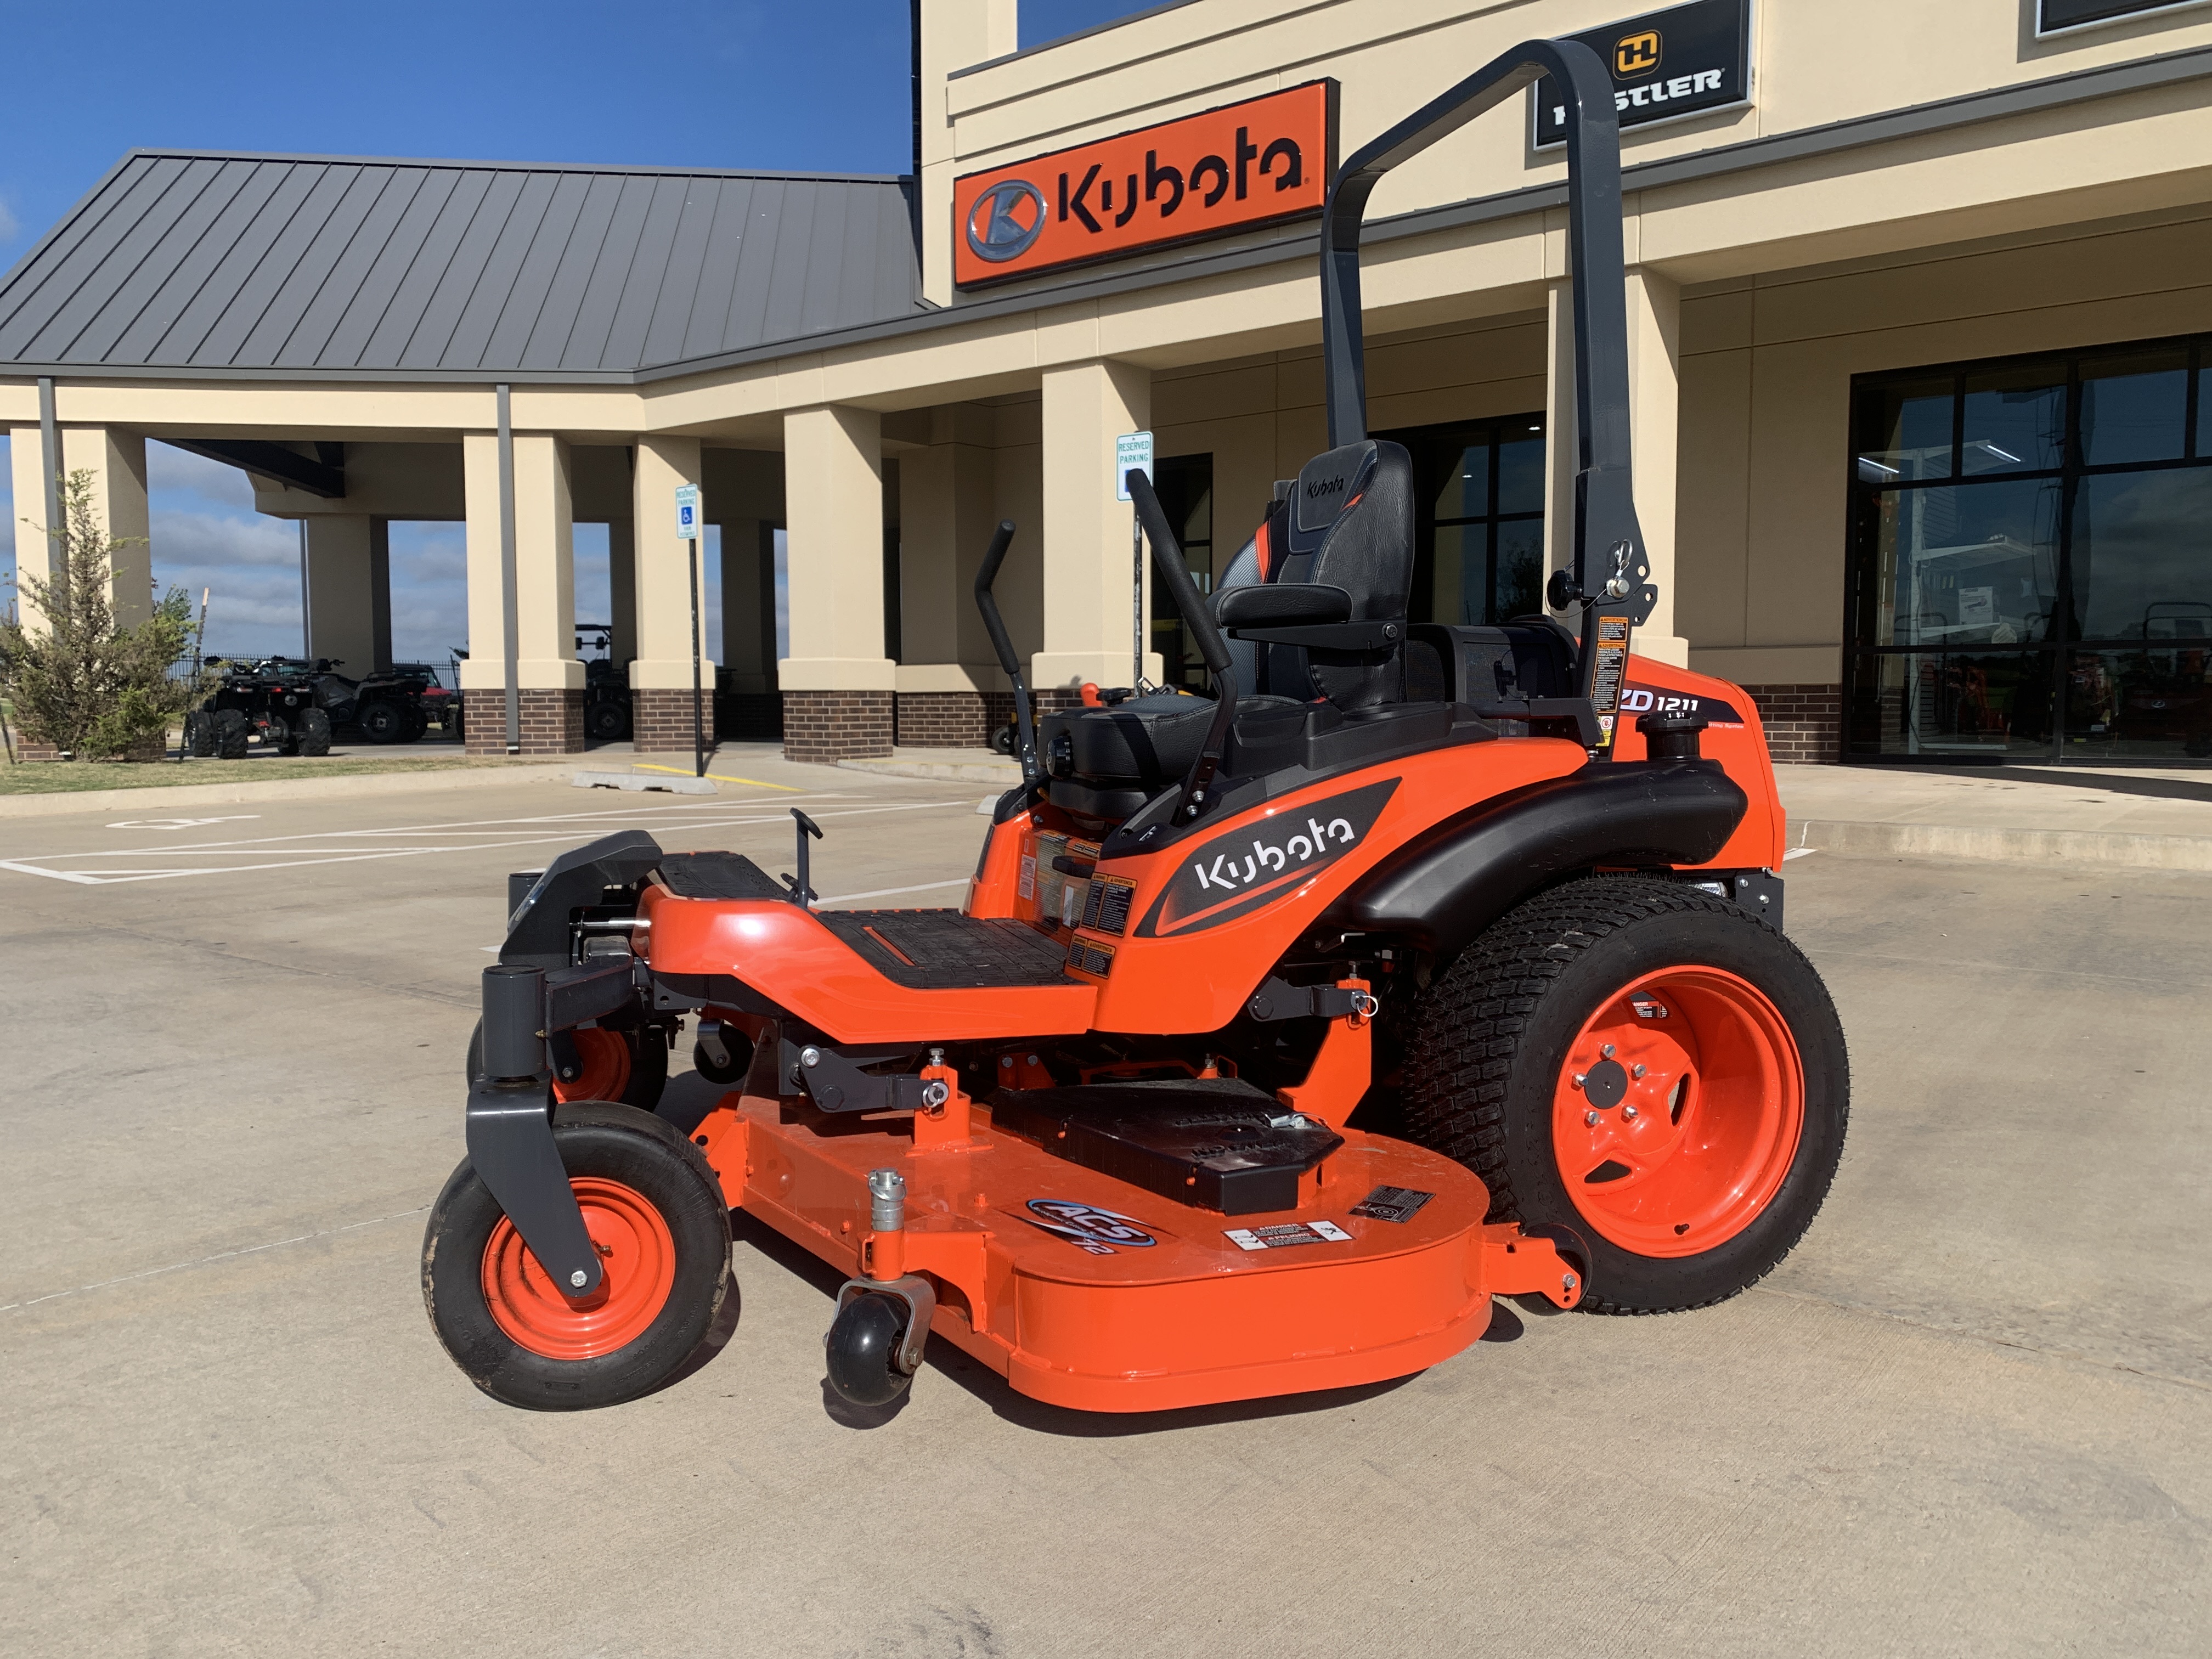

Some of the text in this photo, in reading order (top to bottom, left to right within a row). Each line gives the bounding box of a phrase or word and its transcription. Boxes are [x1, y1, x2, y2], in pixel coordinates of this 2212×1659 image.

[1553, 69, 1722, 126] STLER
[1058, 127, 1302, 233] Kubota
[1118, 441, 1149, 452] RESERVED
[1120, 453, 1149, 464] PARKING
[1307, 475, 1344, 498] Kubota
[1657, 697, 1698, 711] 1211
[1194, 818, 1355, 889] Kubota
[1044, 1206, 1147, 1239] ACS
